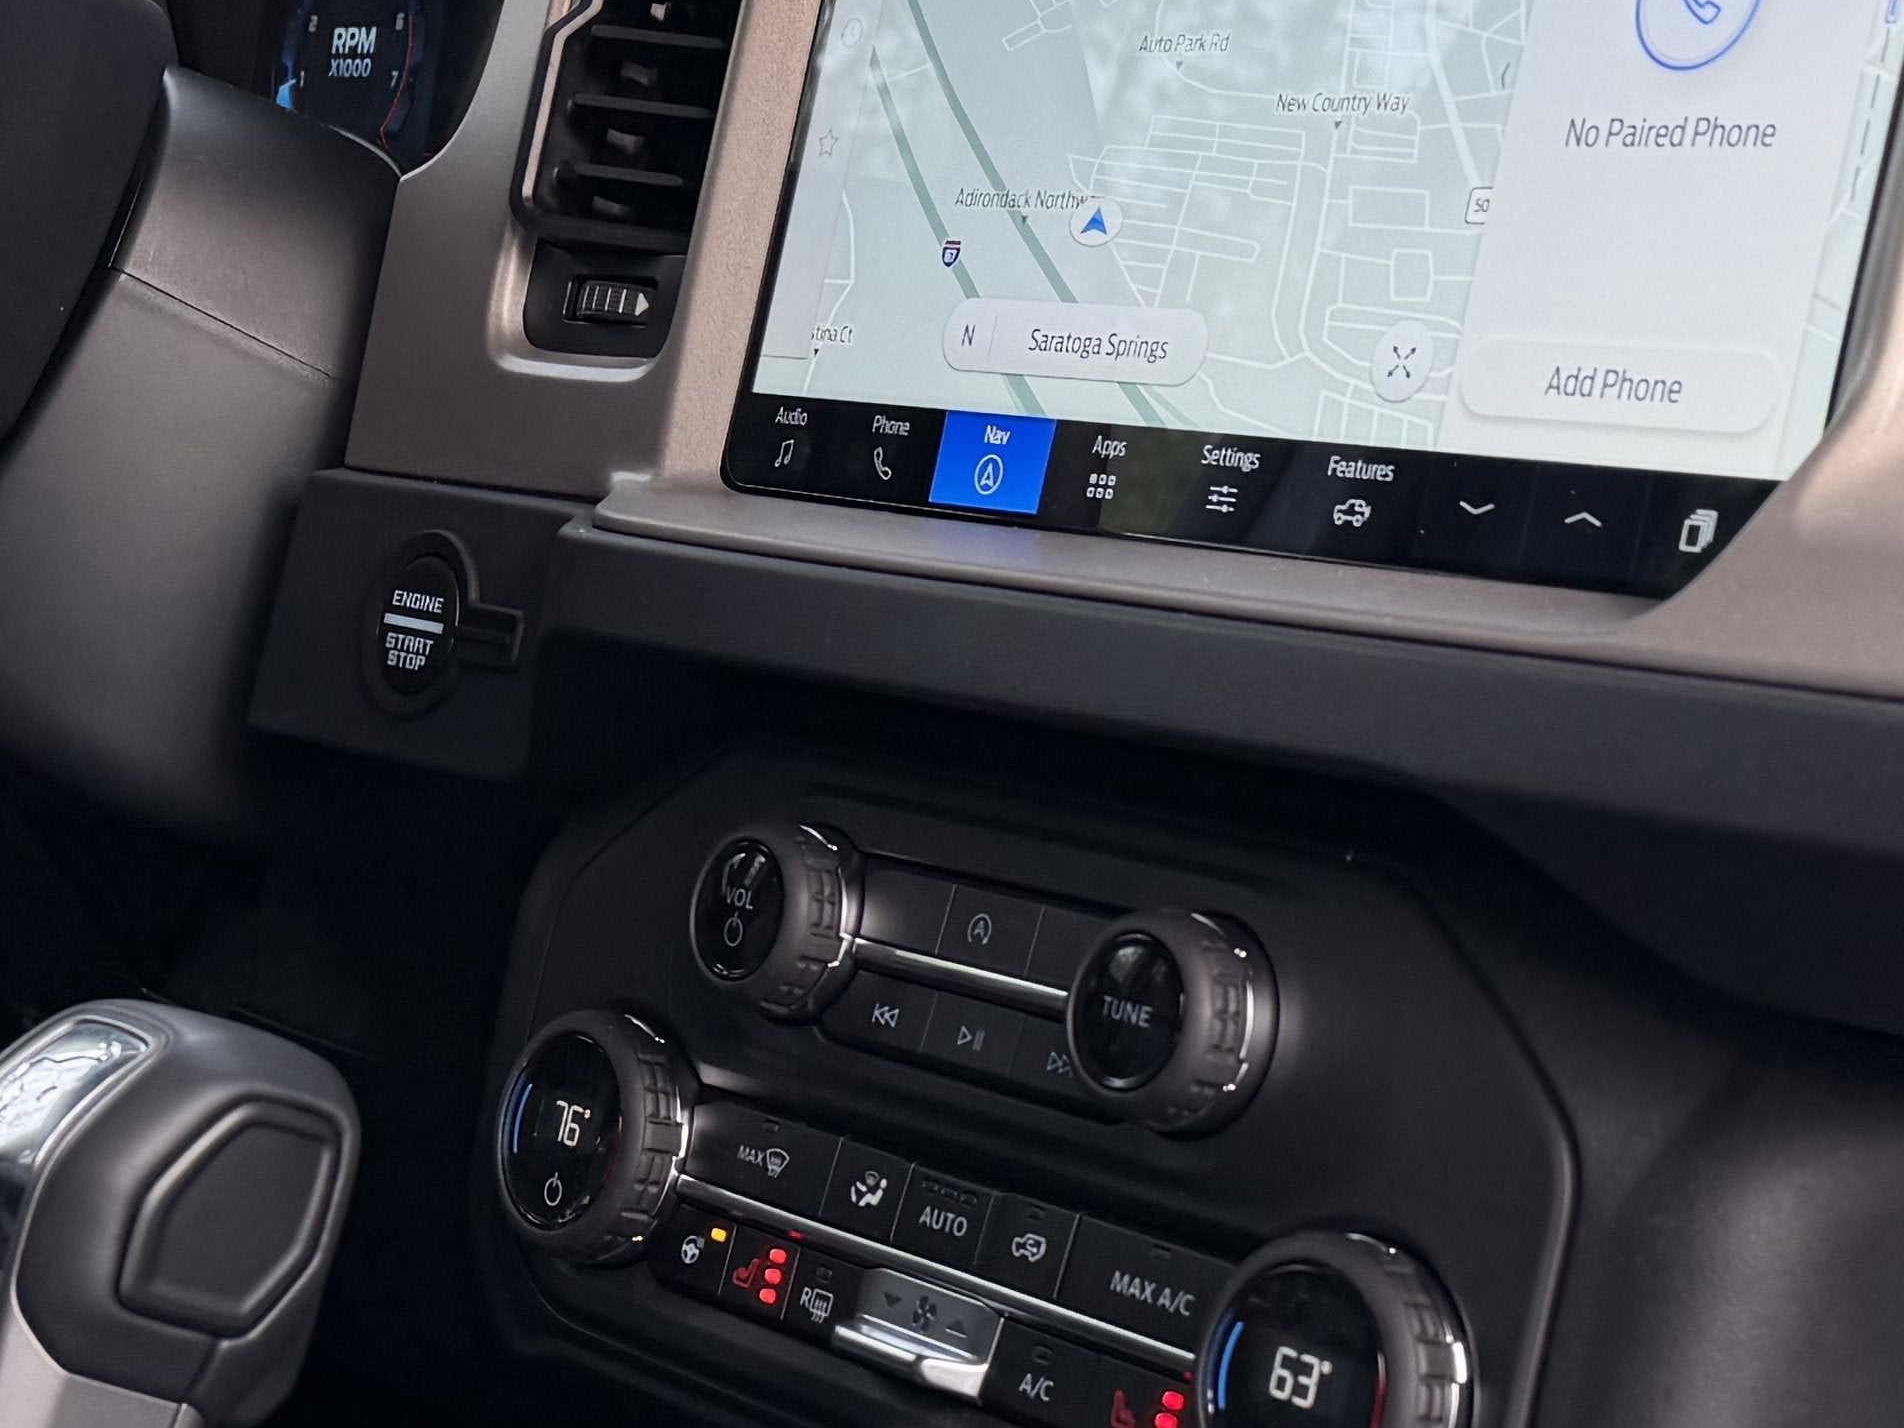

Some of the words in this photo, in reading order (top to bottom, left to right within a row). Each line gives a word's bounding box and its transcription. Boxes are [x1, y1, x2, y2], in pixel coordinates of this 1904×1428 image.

[331, 26, 377, 54] RPM
[1139, 34, 1173, 53] Auto
[1176, 34, 1207, 53] Park
[1209, 33, 1231, 52] Rd
[1276, 93, 1309, 112] New
[1312, 92, 1371, 116] Country
[1375, 93, 1410, 115] Way
[1565, 118, 1600, 148] No
[1605, 117, 1688, 148] Paired
[1691, 116, 1777, 148] Phone
[954, 187, 1031, 209] Adirondack
[961, 324, 976, 347] N
[1029, 329, 1101, 356] Saratoga
[1105, 333, 1169, 361] Springs
[1545, 366, 1597, 397] Add
[1600, 369, 1682, 403] Phone
[775, 406, 807, 426] Audio
[872, 415, 910, 436] Phone
[984, 425, 1010, 445] Nav
[1092, 435, 1127, 458] Apps
[1201, 444, 1260, 472] Settings
[1327, 455, 1395, 482] Features
[392, 590, 444, 614] ENGINE
[385, 632, 434, 656] START
[387, 650, 426, 671] STOP
[726, 886, 754, 909] VOL
[1102, 994, 1152, 1029] TUNE
[737, 1145, 764, 1166] MAX
[919, 1206, 968, 1237] AUTO
[1109, 1270, 1156, 1303] MAX
[1157, 1286, 1195, 1317] A/C
[1019, 1373, 1054, 1402] A/C
